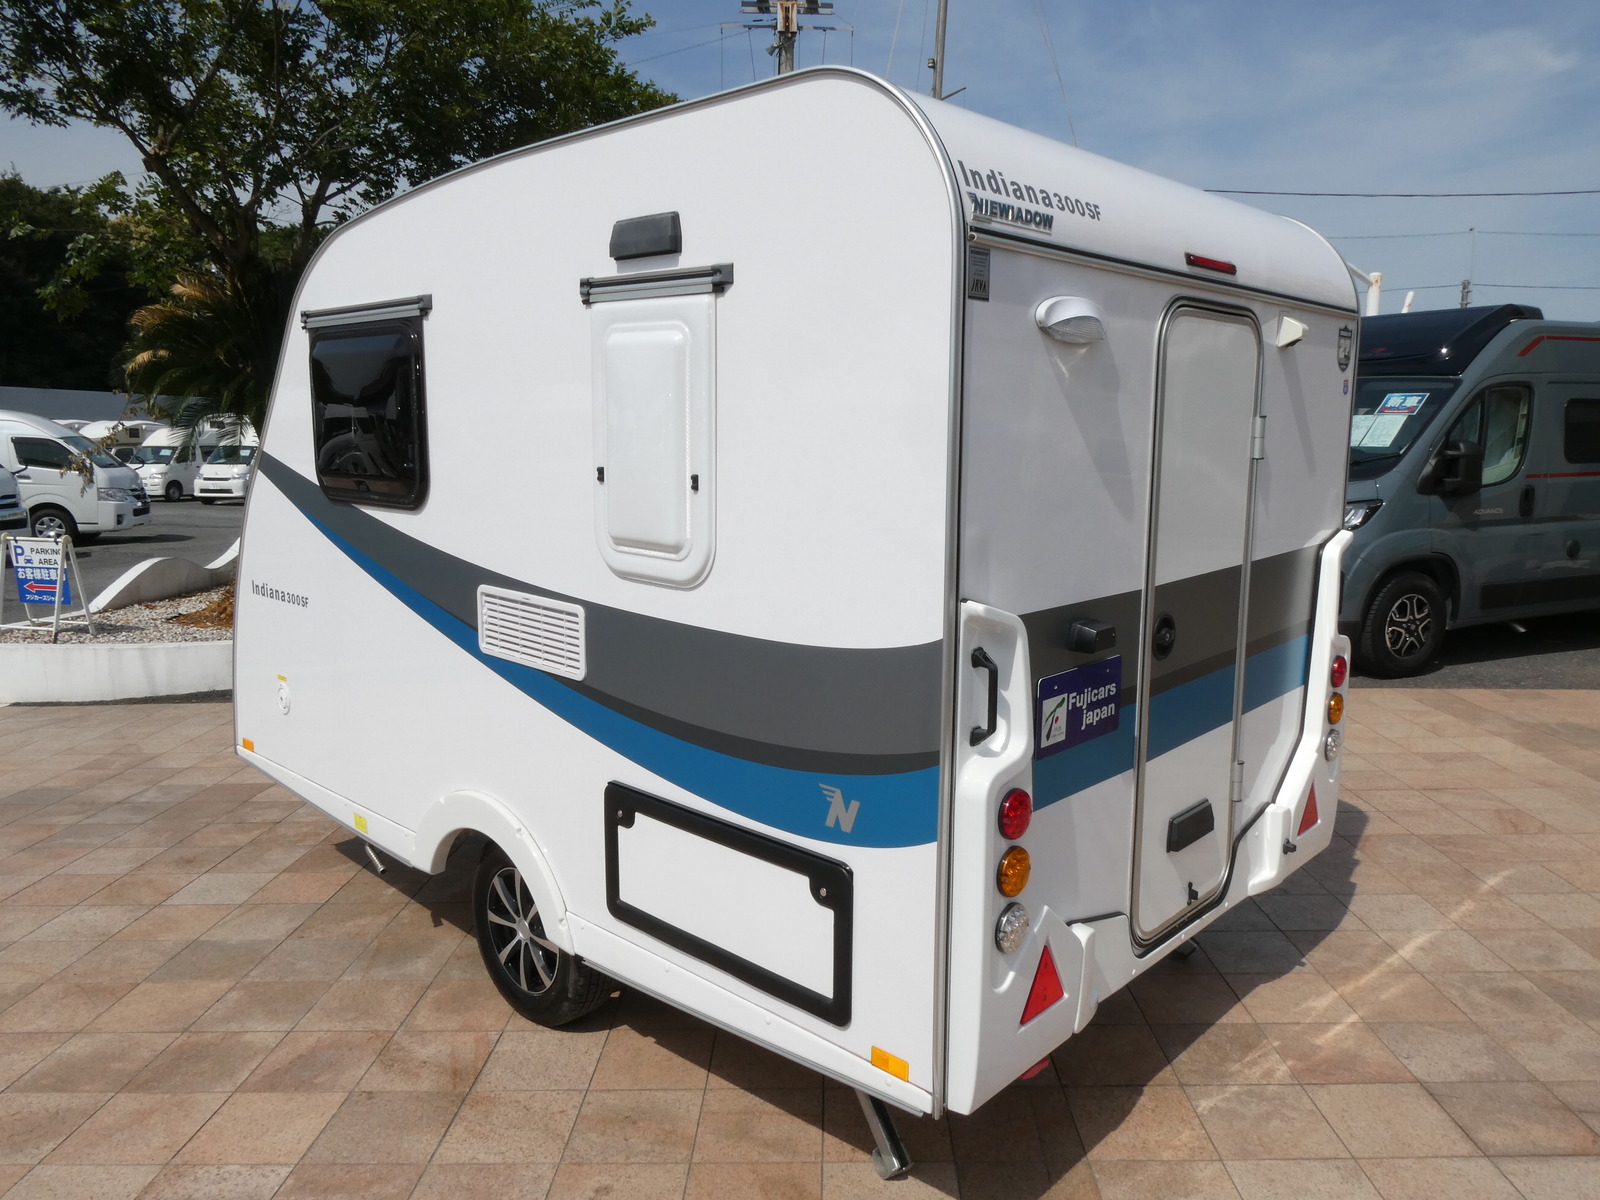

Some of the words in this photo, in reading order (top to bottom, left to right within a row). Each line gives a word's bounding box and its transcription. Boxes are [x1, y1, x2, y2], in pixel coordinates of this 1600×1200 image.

[957, 159, 1101, 222] Indiana300SF
[970, 194, 1054, 230] NIEWIADOW
[13, 545, 25, 564] P
[38, 558, 59, 566] AREA
[17, 567, 66, 581] お客様駐車
[251, 579, 309, 608] Indiana300SF
[1068, 682, 1117, 710] Fujicars
[1081, 703, 1115, 730] japan
